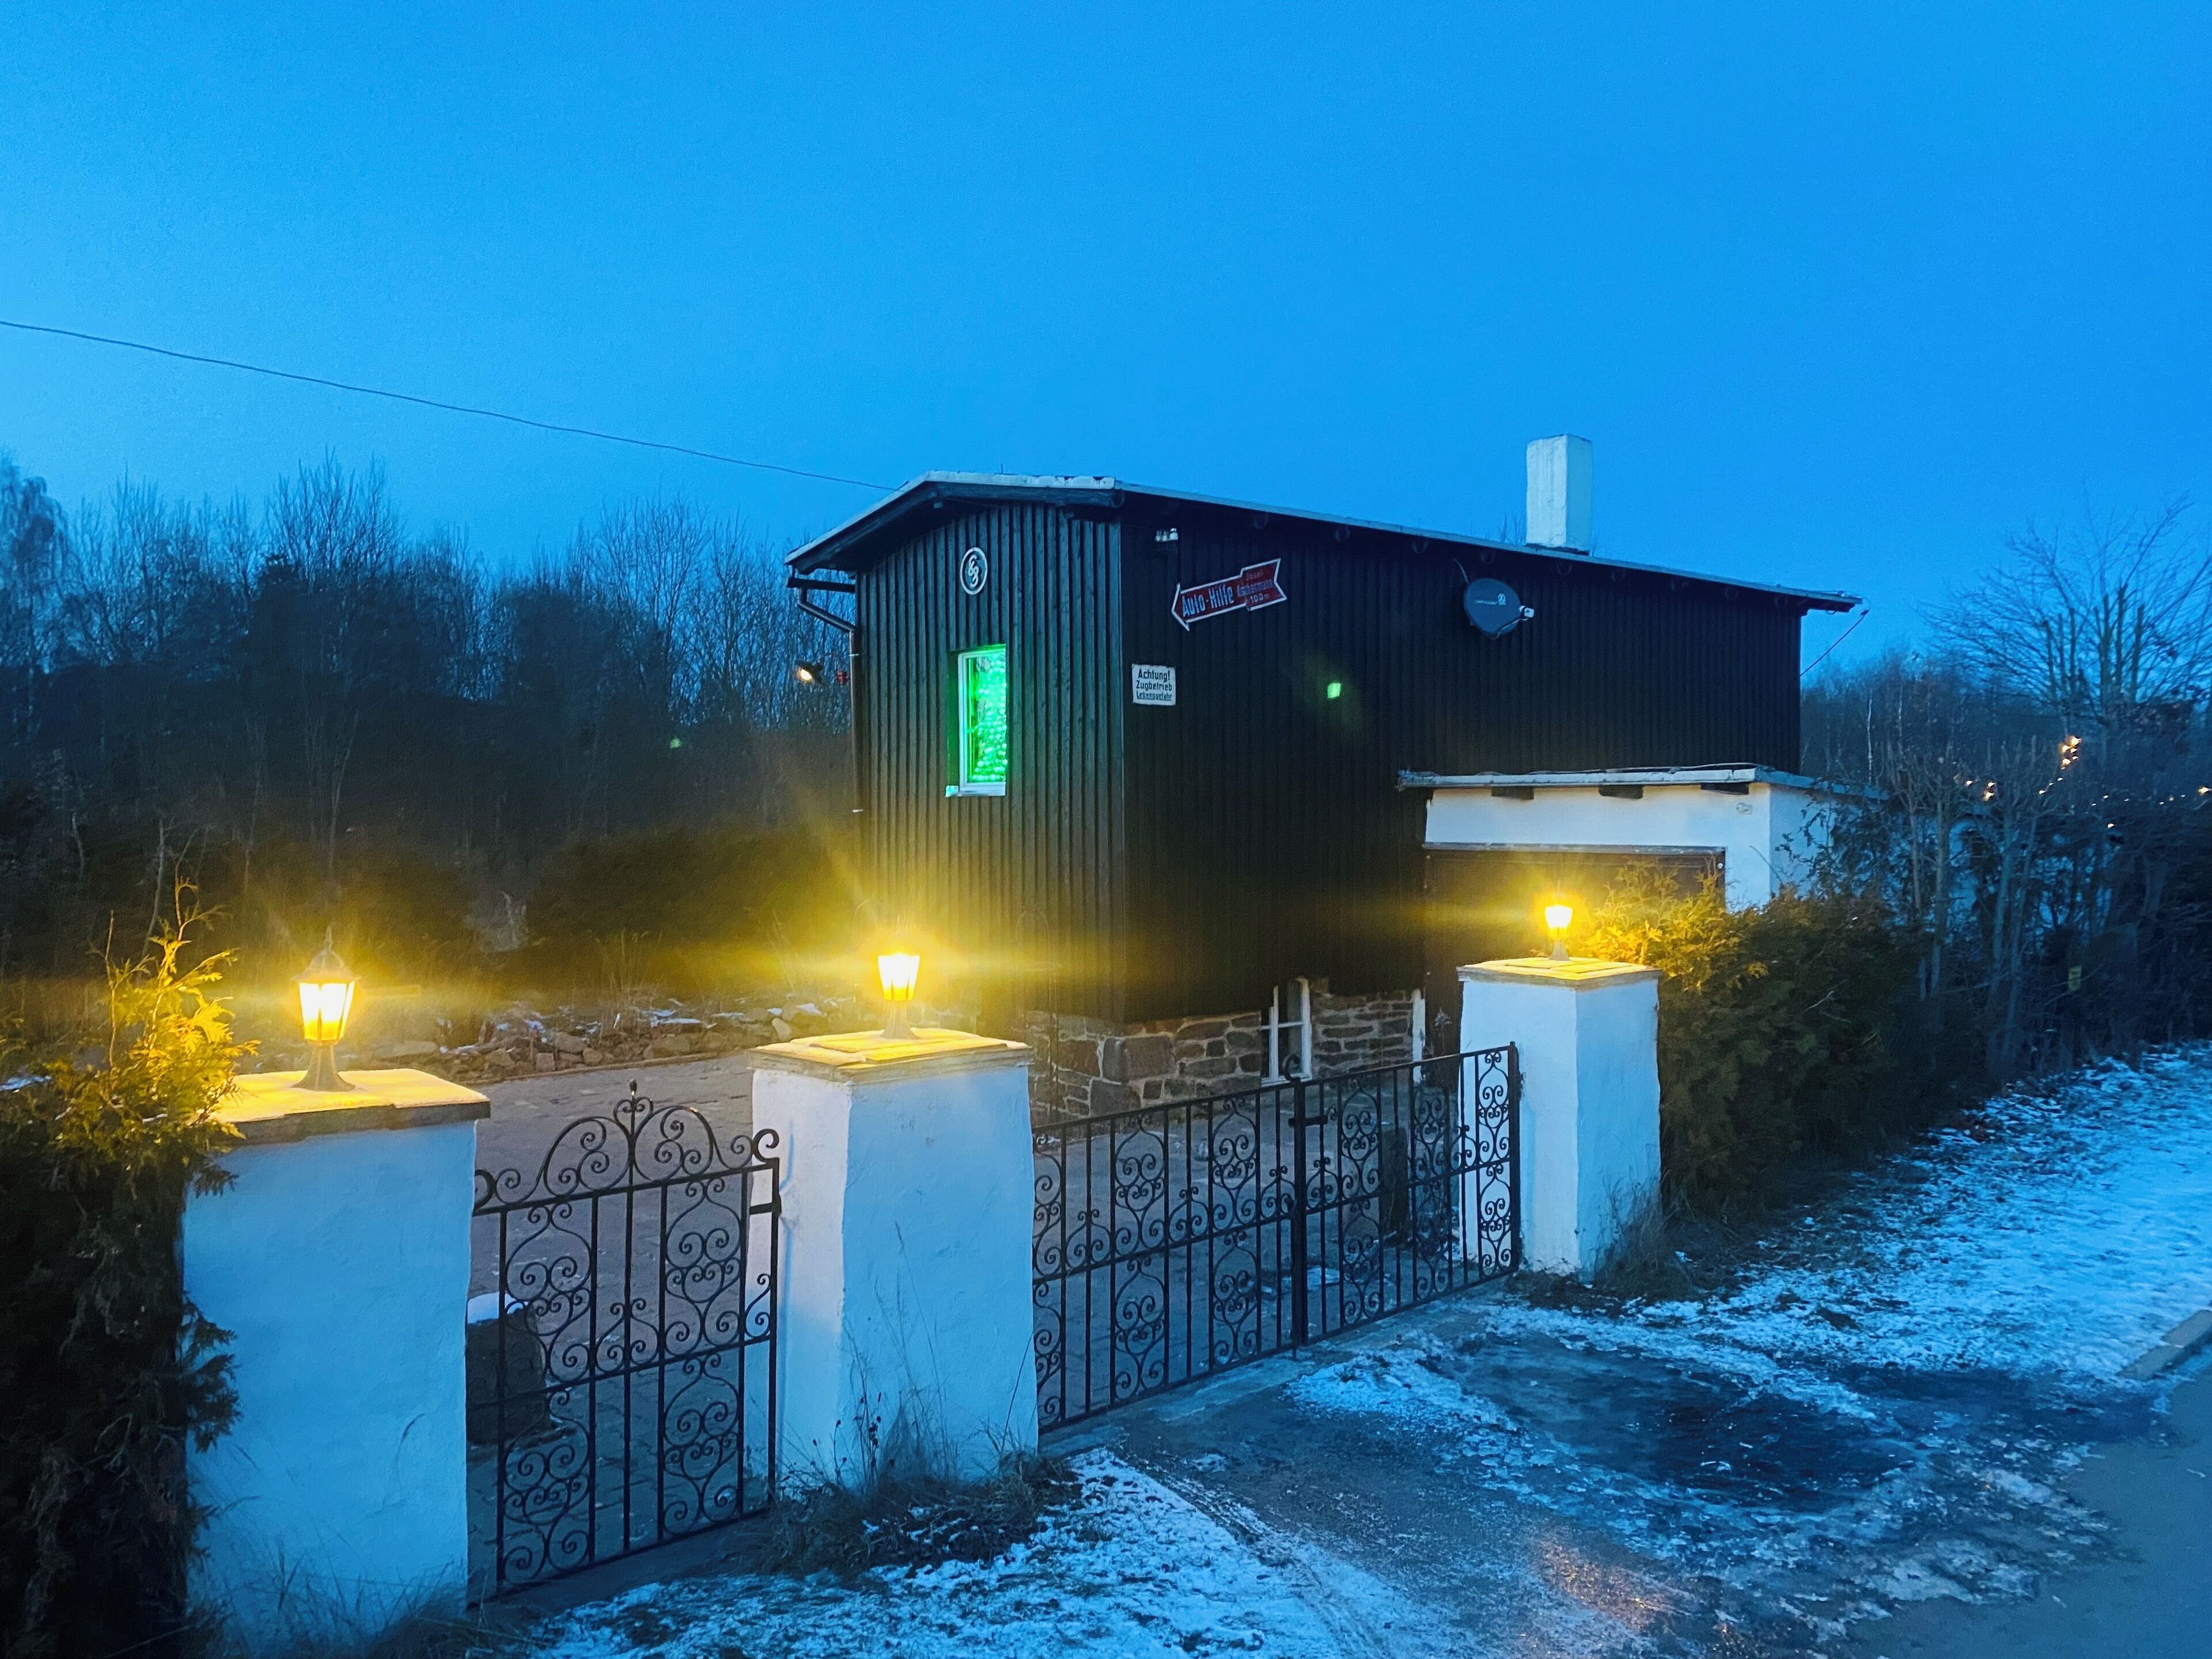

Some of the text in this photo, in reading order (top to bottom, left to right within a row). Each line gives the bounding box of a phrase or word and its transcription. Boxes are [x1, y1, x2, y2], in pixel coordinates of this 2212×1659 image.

[1182, 584, 1234, 618] Auto-Hilfe
[1138, 668, 1170, 683] Achtung!
[1136, 680, 1172, 691] Zugbetrieb
